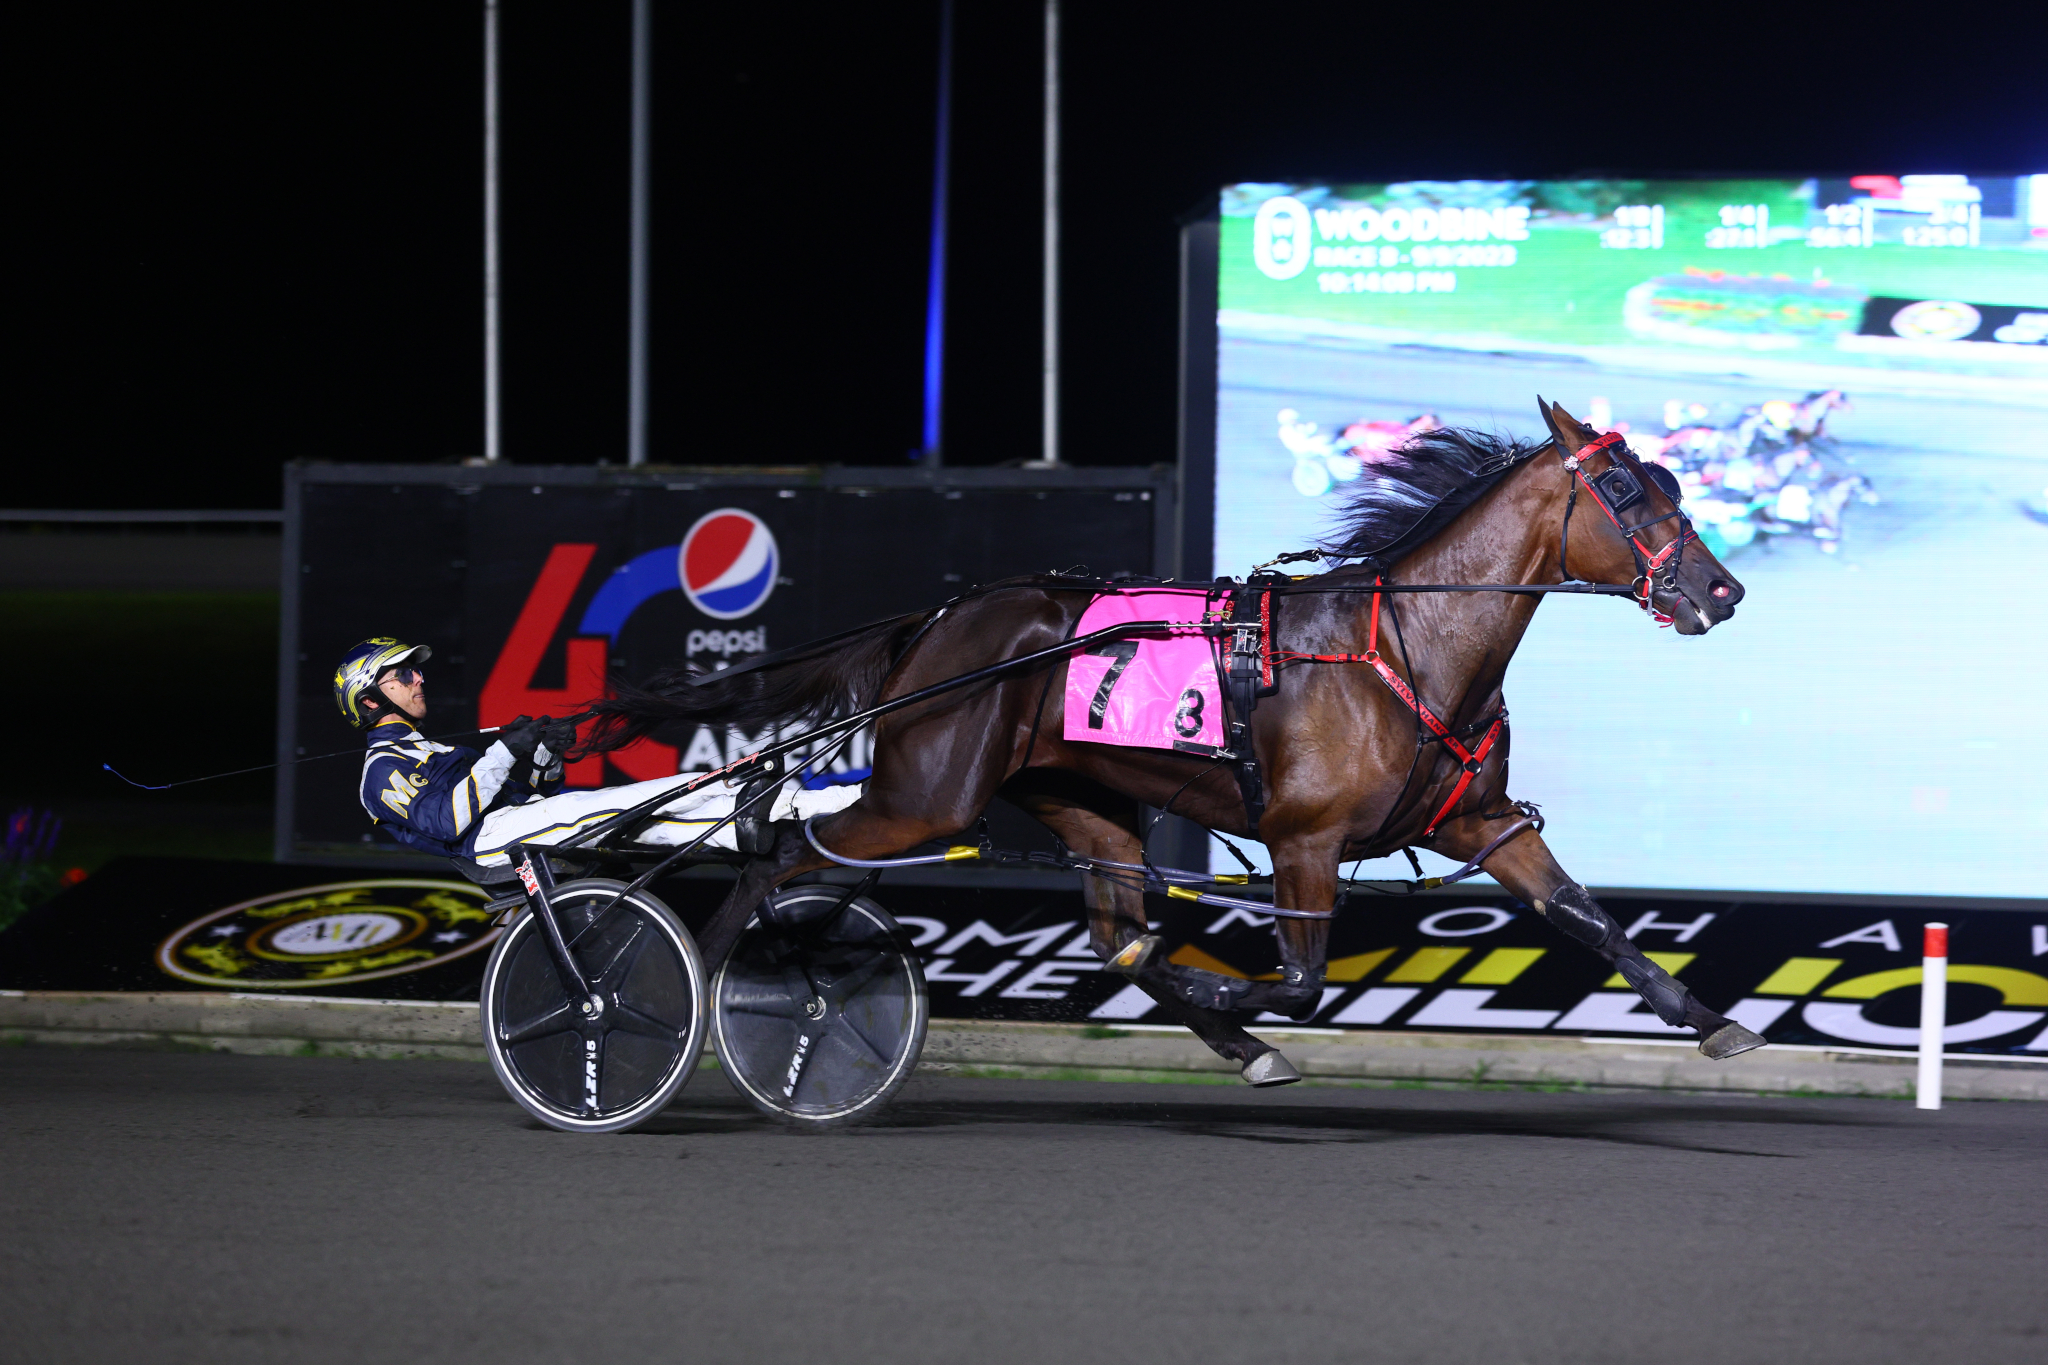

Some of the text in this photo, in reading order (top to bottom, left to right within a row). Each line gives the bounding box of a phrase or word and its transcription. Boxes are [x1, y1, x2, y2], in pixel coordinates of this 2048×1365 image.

[1314, 207, 1530, 241] WOODBINE
[686, 625, 766, 658] pepsi
[1084, 640, 1139, 730] 7
[1390, 676, 1459, 749] SYLVI HANOER
[679, 717, 876, 776] AMERI
[1087, 943, 2048, 1051] MILLIO
